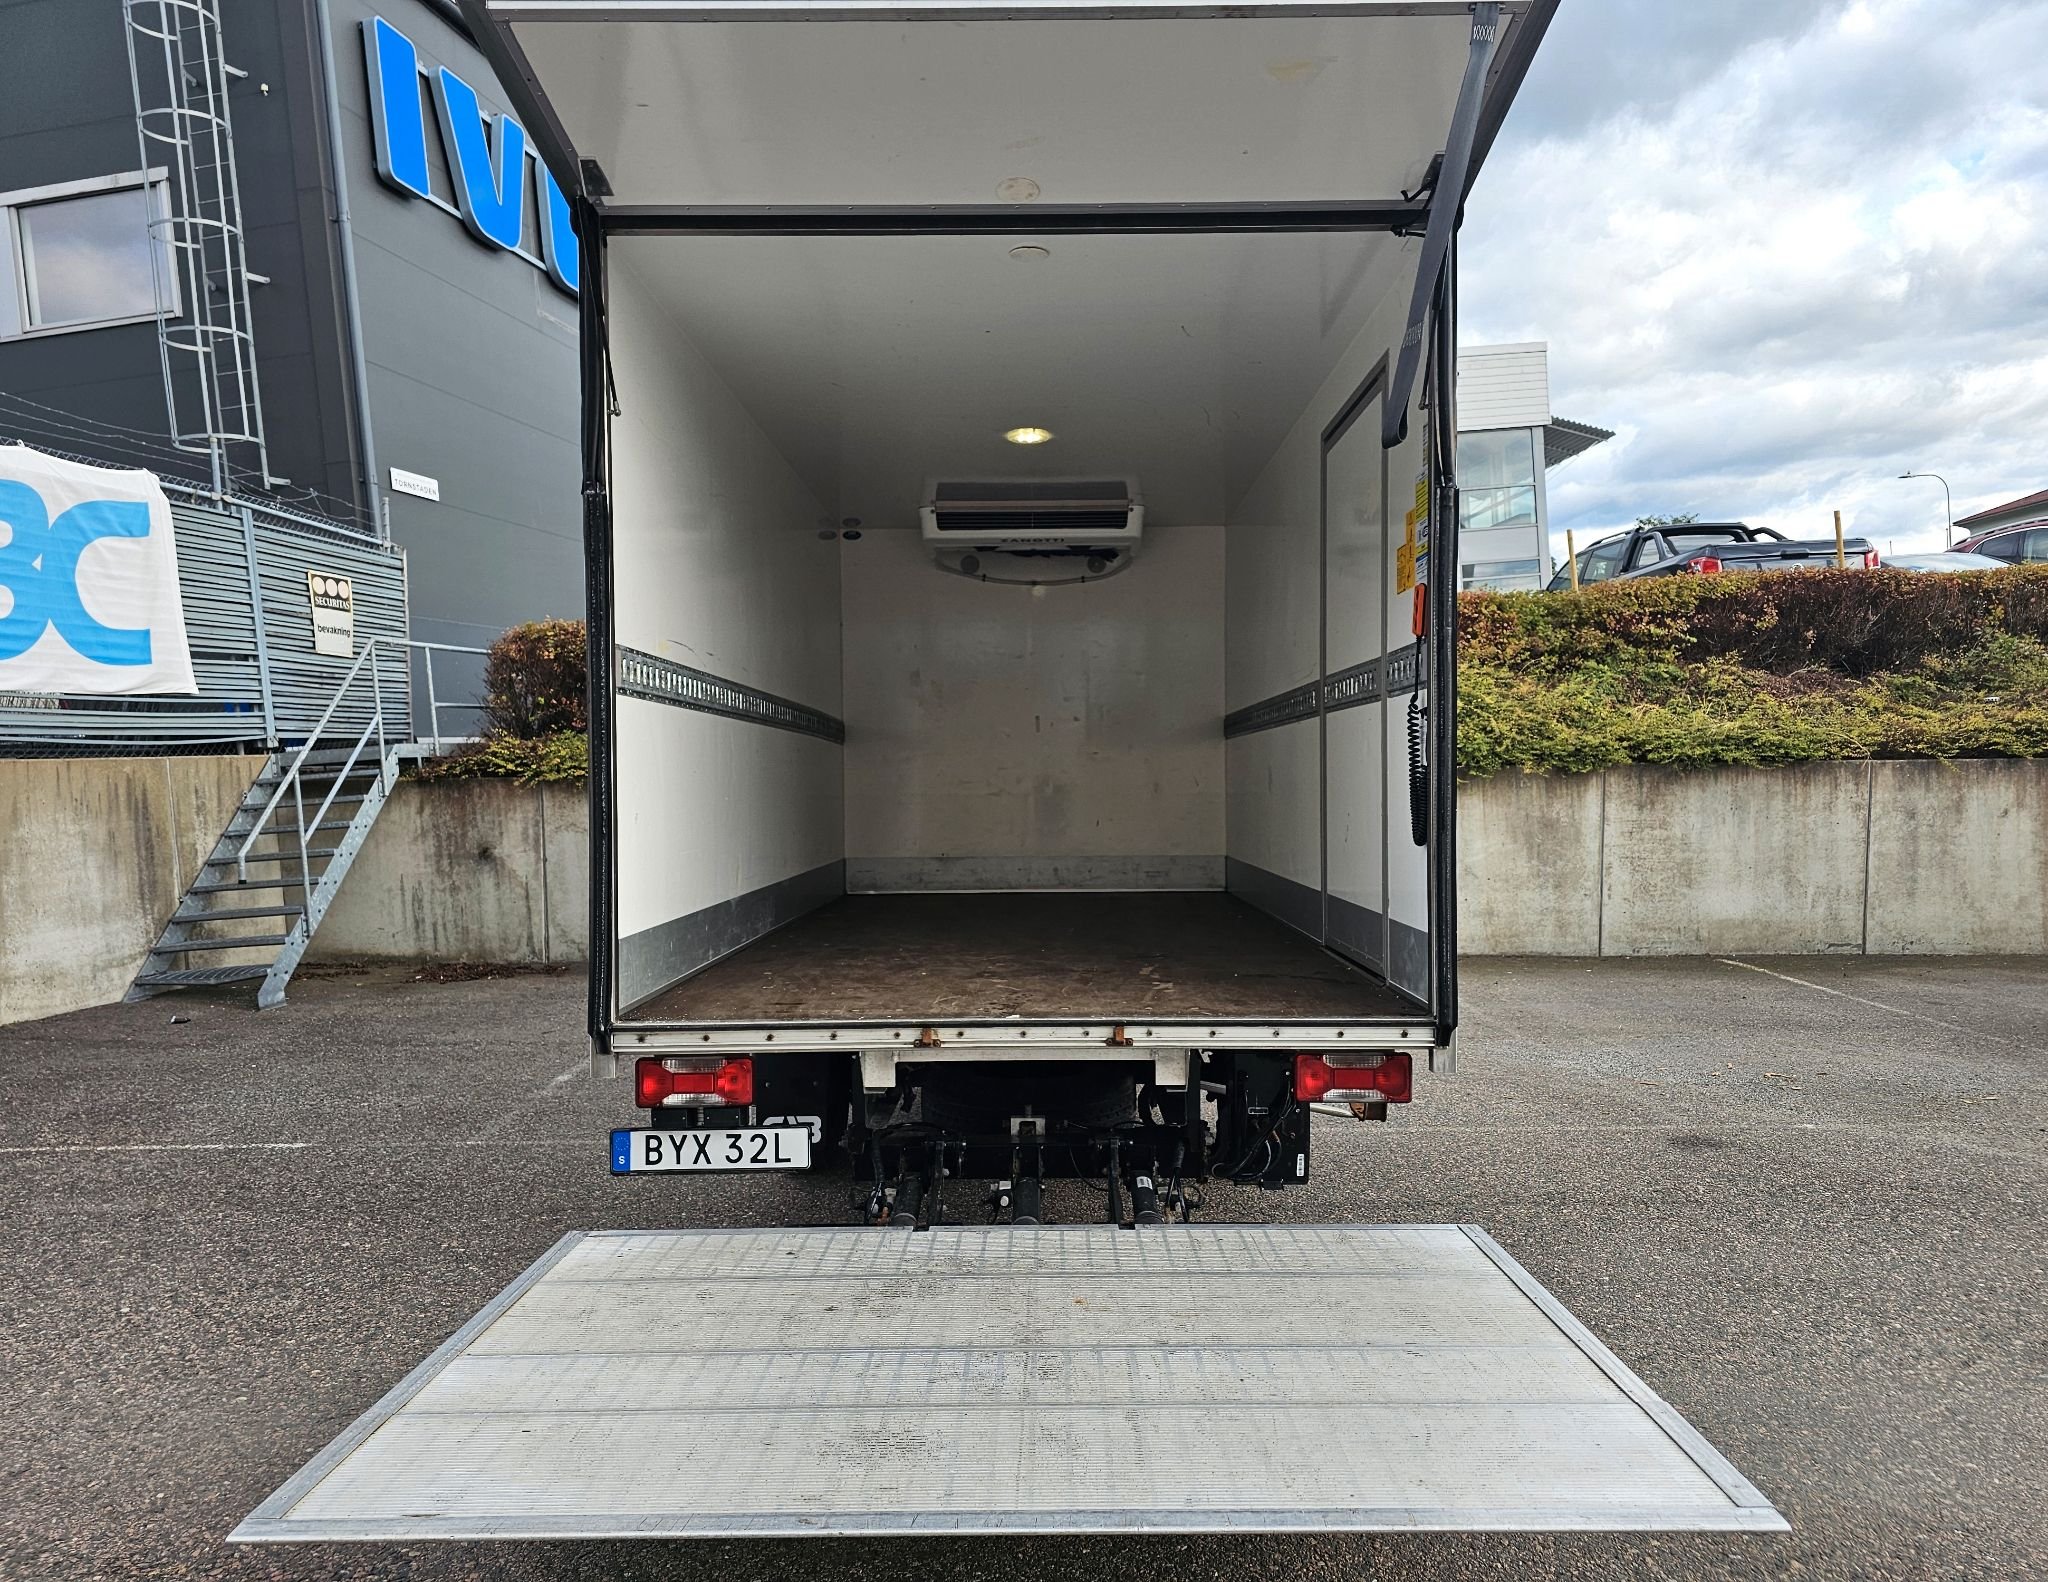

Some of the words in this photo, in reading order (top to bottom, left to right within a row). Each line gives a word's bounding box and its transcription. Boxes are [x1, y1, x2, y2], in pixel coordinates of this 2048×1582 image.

[315, 596, 350, 610] SECURITAS
[317, 624, 350, 638] bevakning
[645, 1134, 712, 1166] BYX
[725, 1133, 792, 1164] 32L
[618, 1155, 625, 1165] S
